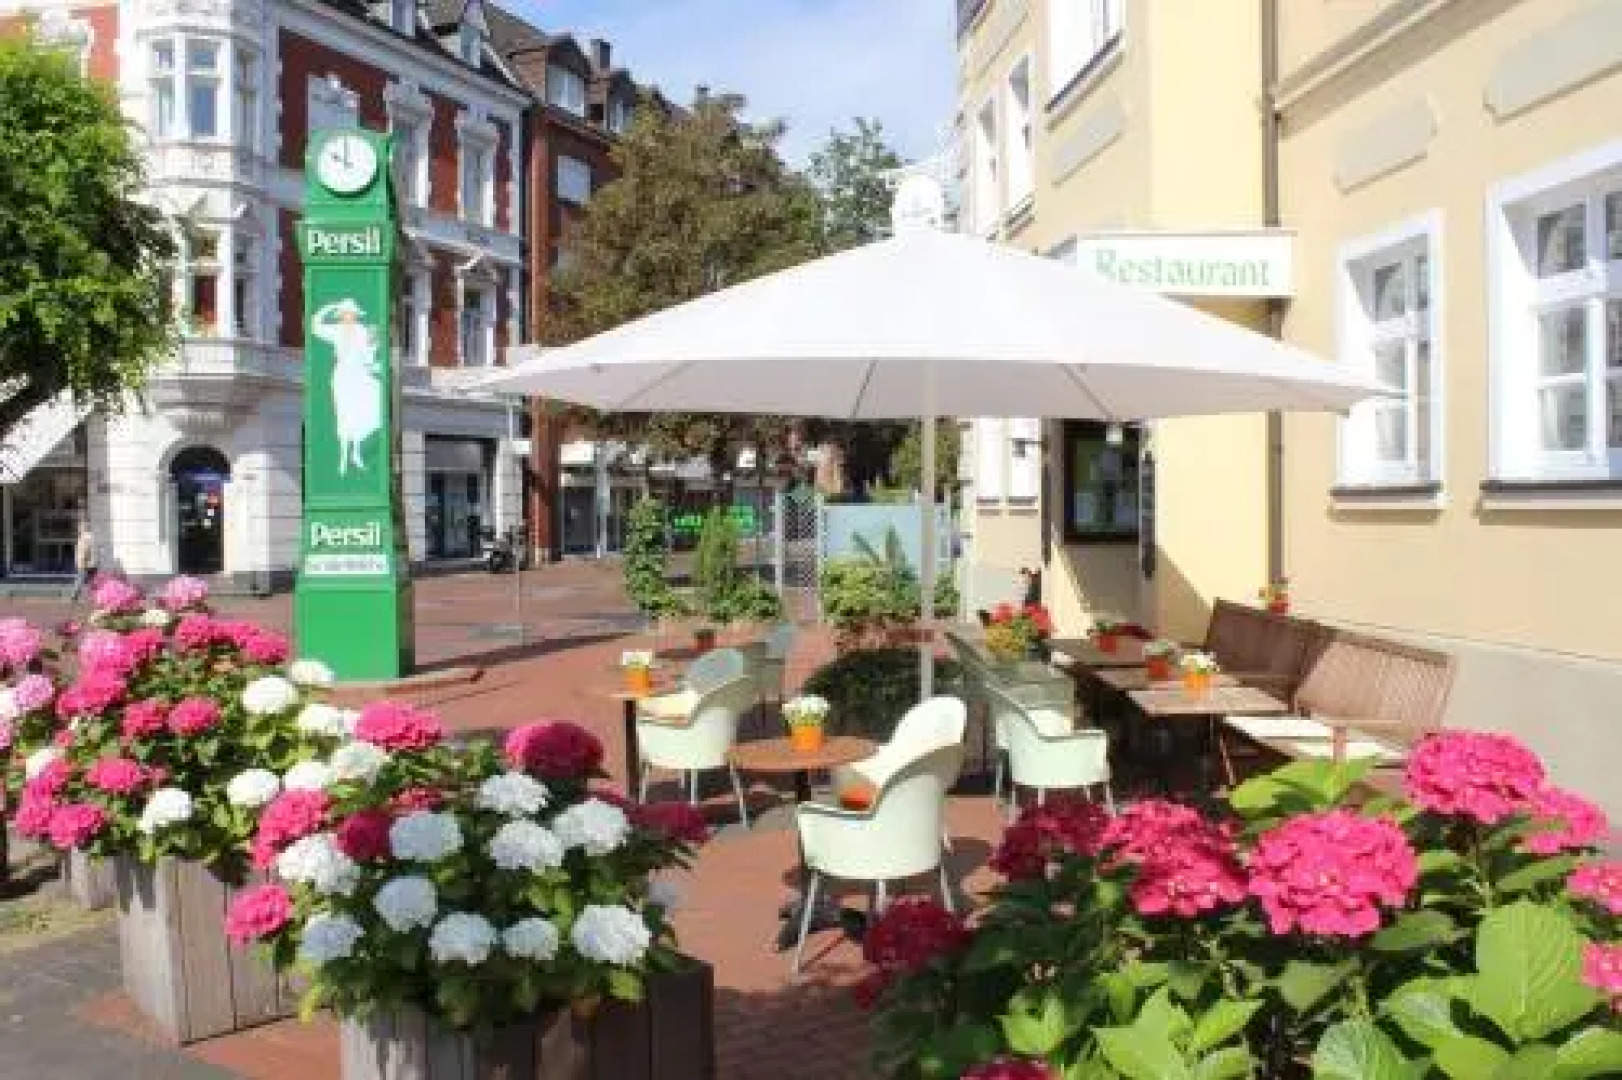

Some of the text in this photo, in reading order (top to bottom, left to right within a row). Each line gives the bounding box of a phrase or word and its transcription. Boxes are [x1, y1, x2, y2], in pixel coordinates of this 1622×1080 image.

[308, 227, 381, 255] Persil
[1094, 248, 1270, 286] Restaurant
[310, 521, 381, 547] Persil
